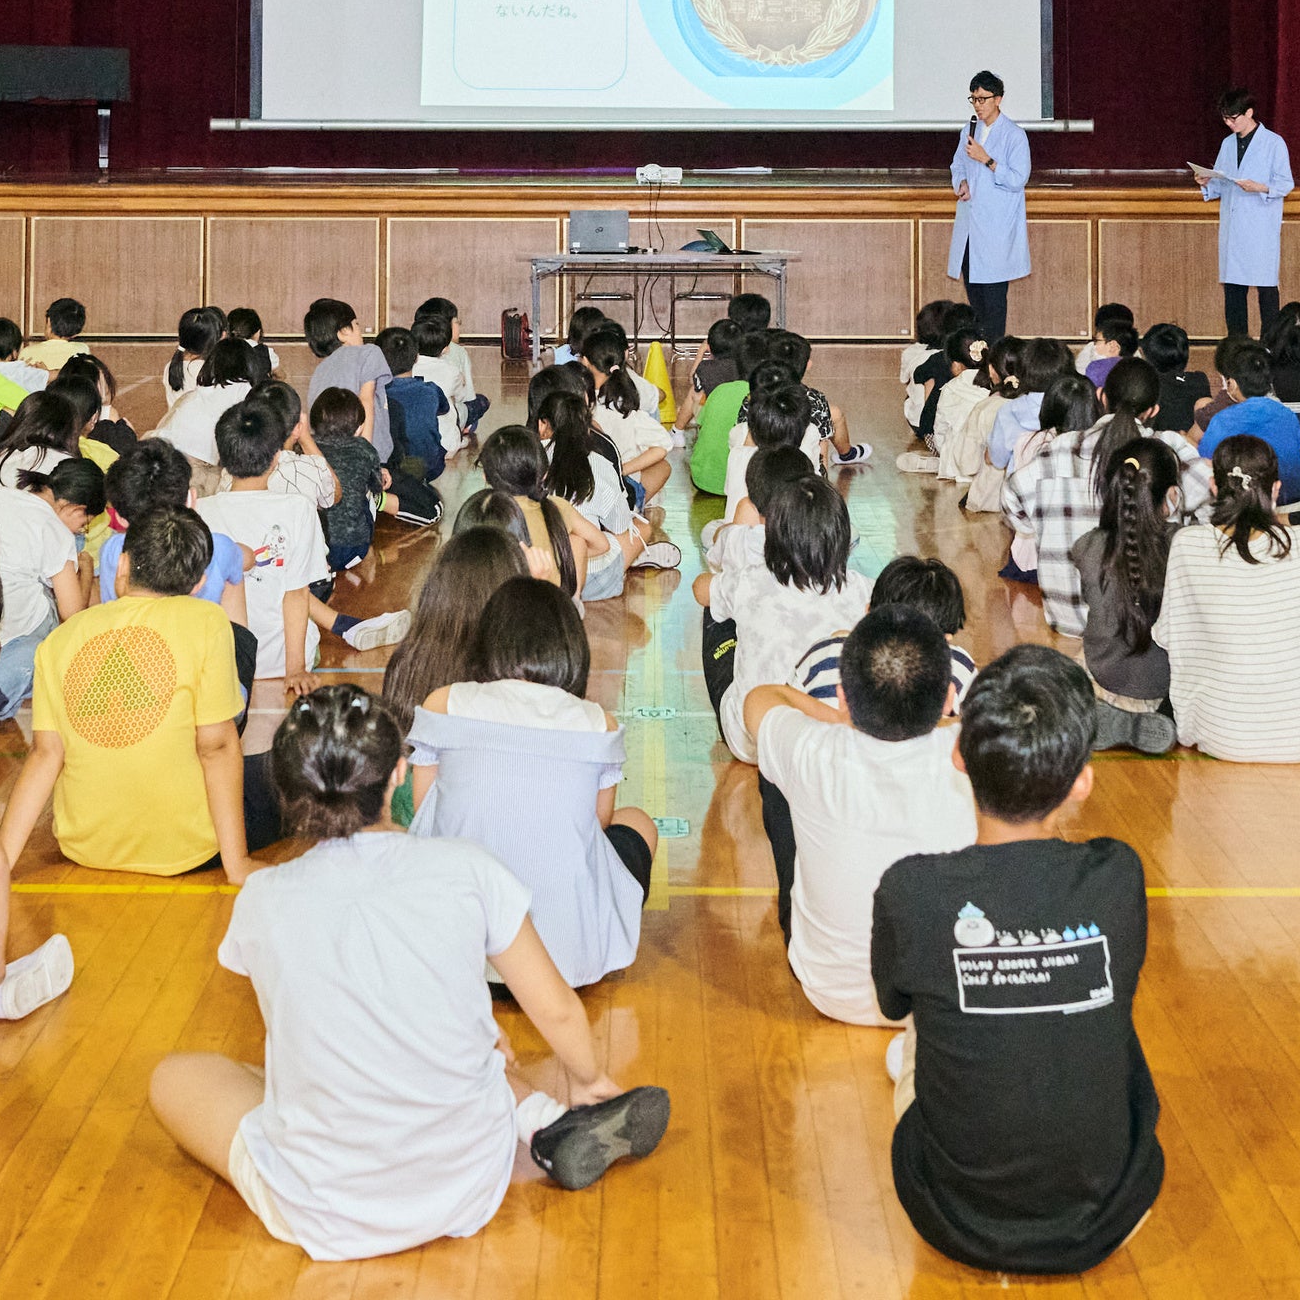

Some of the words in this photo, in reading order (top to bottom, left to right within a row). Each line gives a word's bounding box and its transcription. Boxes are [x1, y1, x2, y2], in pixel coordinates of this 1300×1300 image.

[495, 4, 578, 19] ないんだね。
